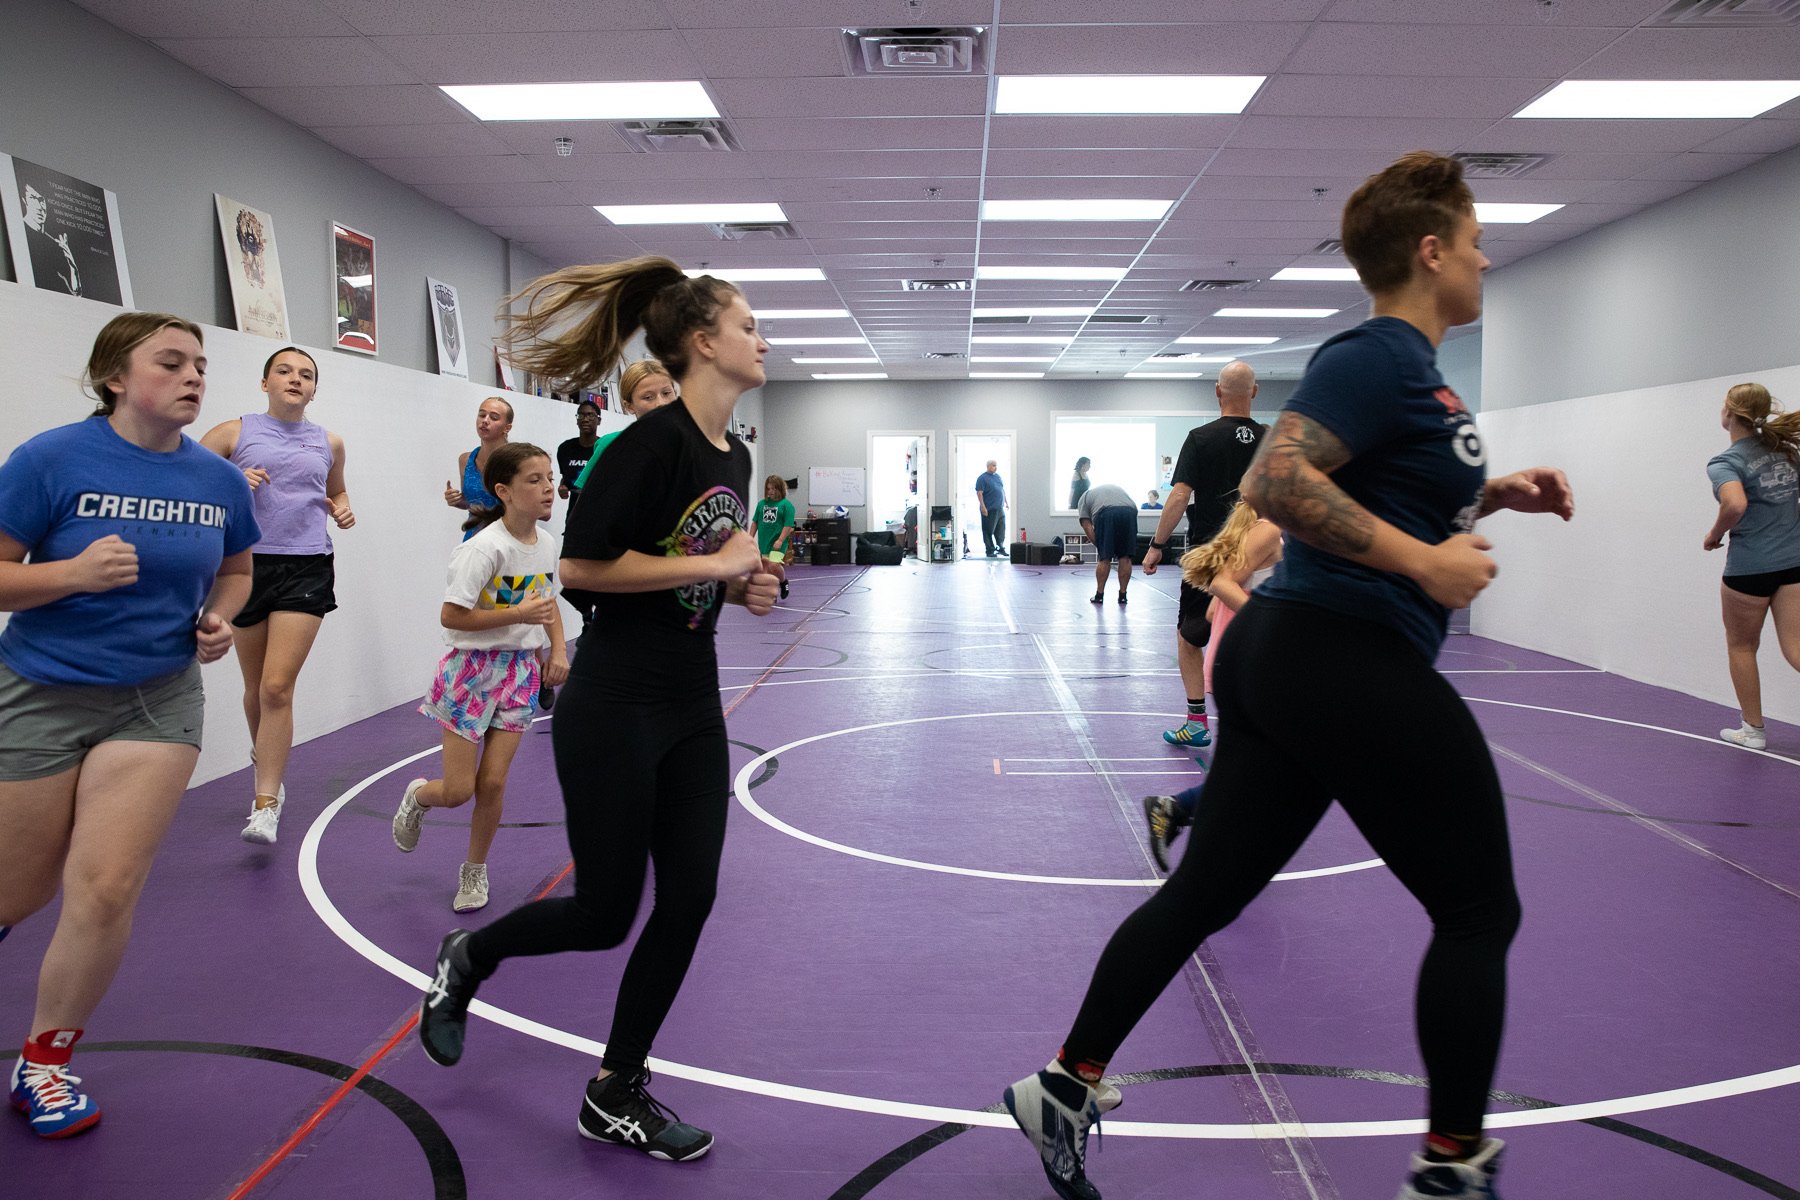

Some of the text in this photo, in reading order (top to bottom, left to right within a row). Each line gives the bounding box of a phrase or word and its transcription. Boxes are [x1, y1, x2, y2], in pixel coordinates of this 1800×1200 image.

[75, 492, 227, 529] CREIGHTON
[682, 493, 748, 539] GRATEFU
[121, 525, 201, 538] TENNIS
